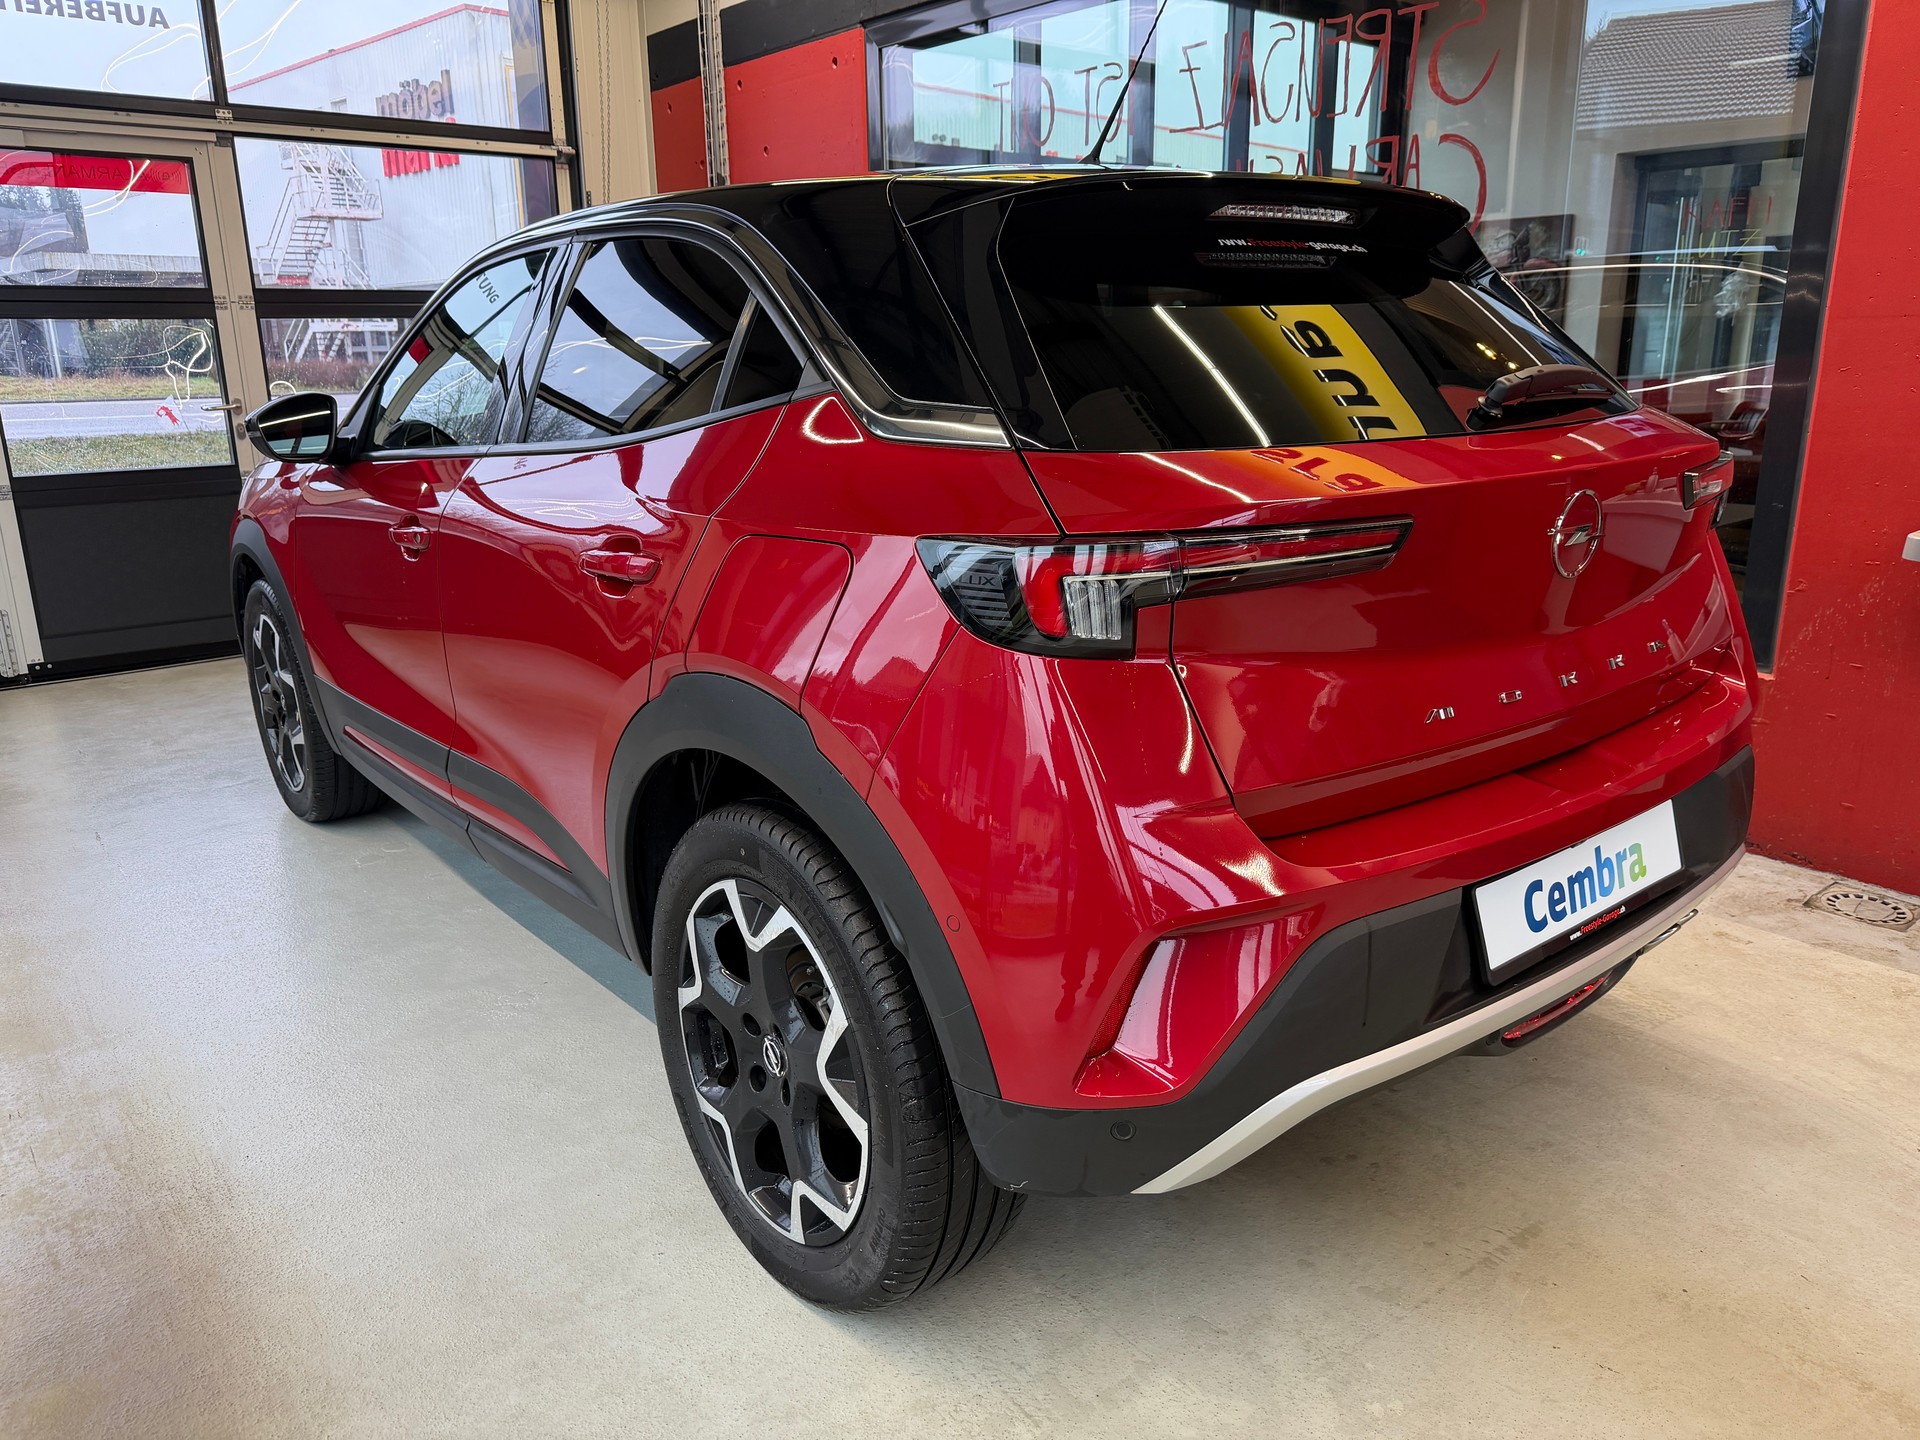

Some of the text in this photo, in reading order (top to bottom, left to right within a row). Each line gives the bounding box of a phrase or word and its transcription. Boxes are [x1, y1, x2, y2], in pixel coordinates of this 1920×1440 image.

[375, 69, 455, 120] möbel
[1423, 639, 1666, 724] MOKKA
[1523, 842, 1648, 934] Cembra
